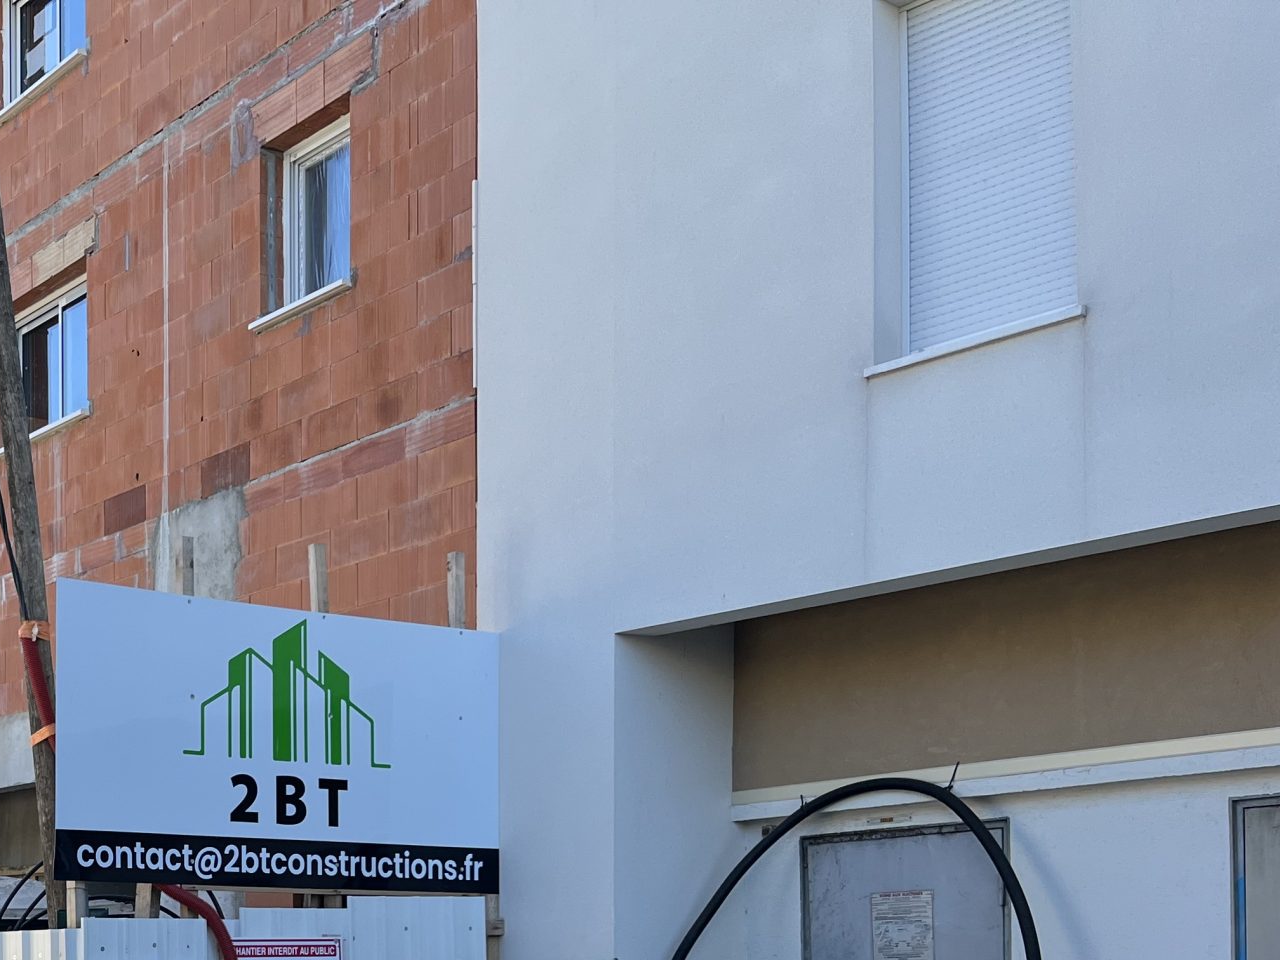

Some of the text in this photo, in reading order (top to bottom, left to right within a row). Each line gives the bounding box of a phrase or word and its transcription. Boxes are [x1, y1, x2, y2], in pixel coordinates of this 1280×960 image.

[76, 841, 483, 882] contact@2btconstructions.fr
[234, 946, 335, 956] HANTIER INTERDIT AU PUBLIC
